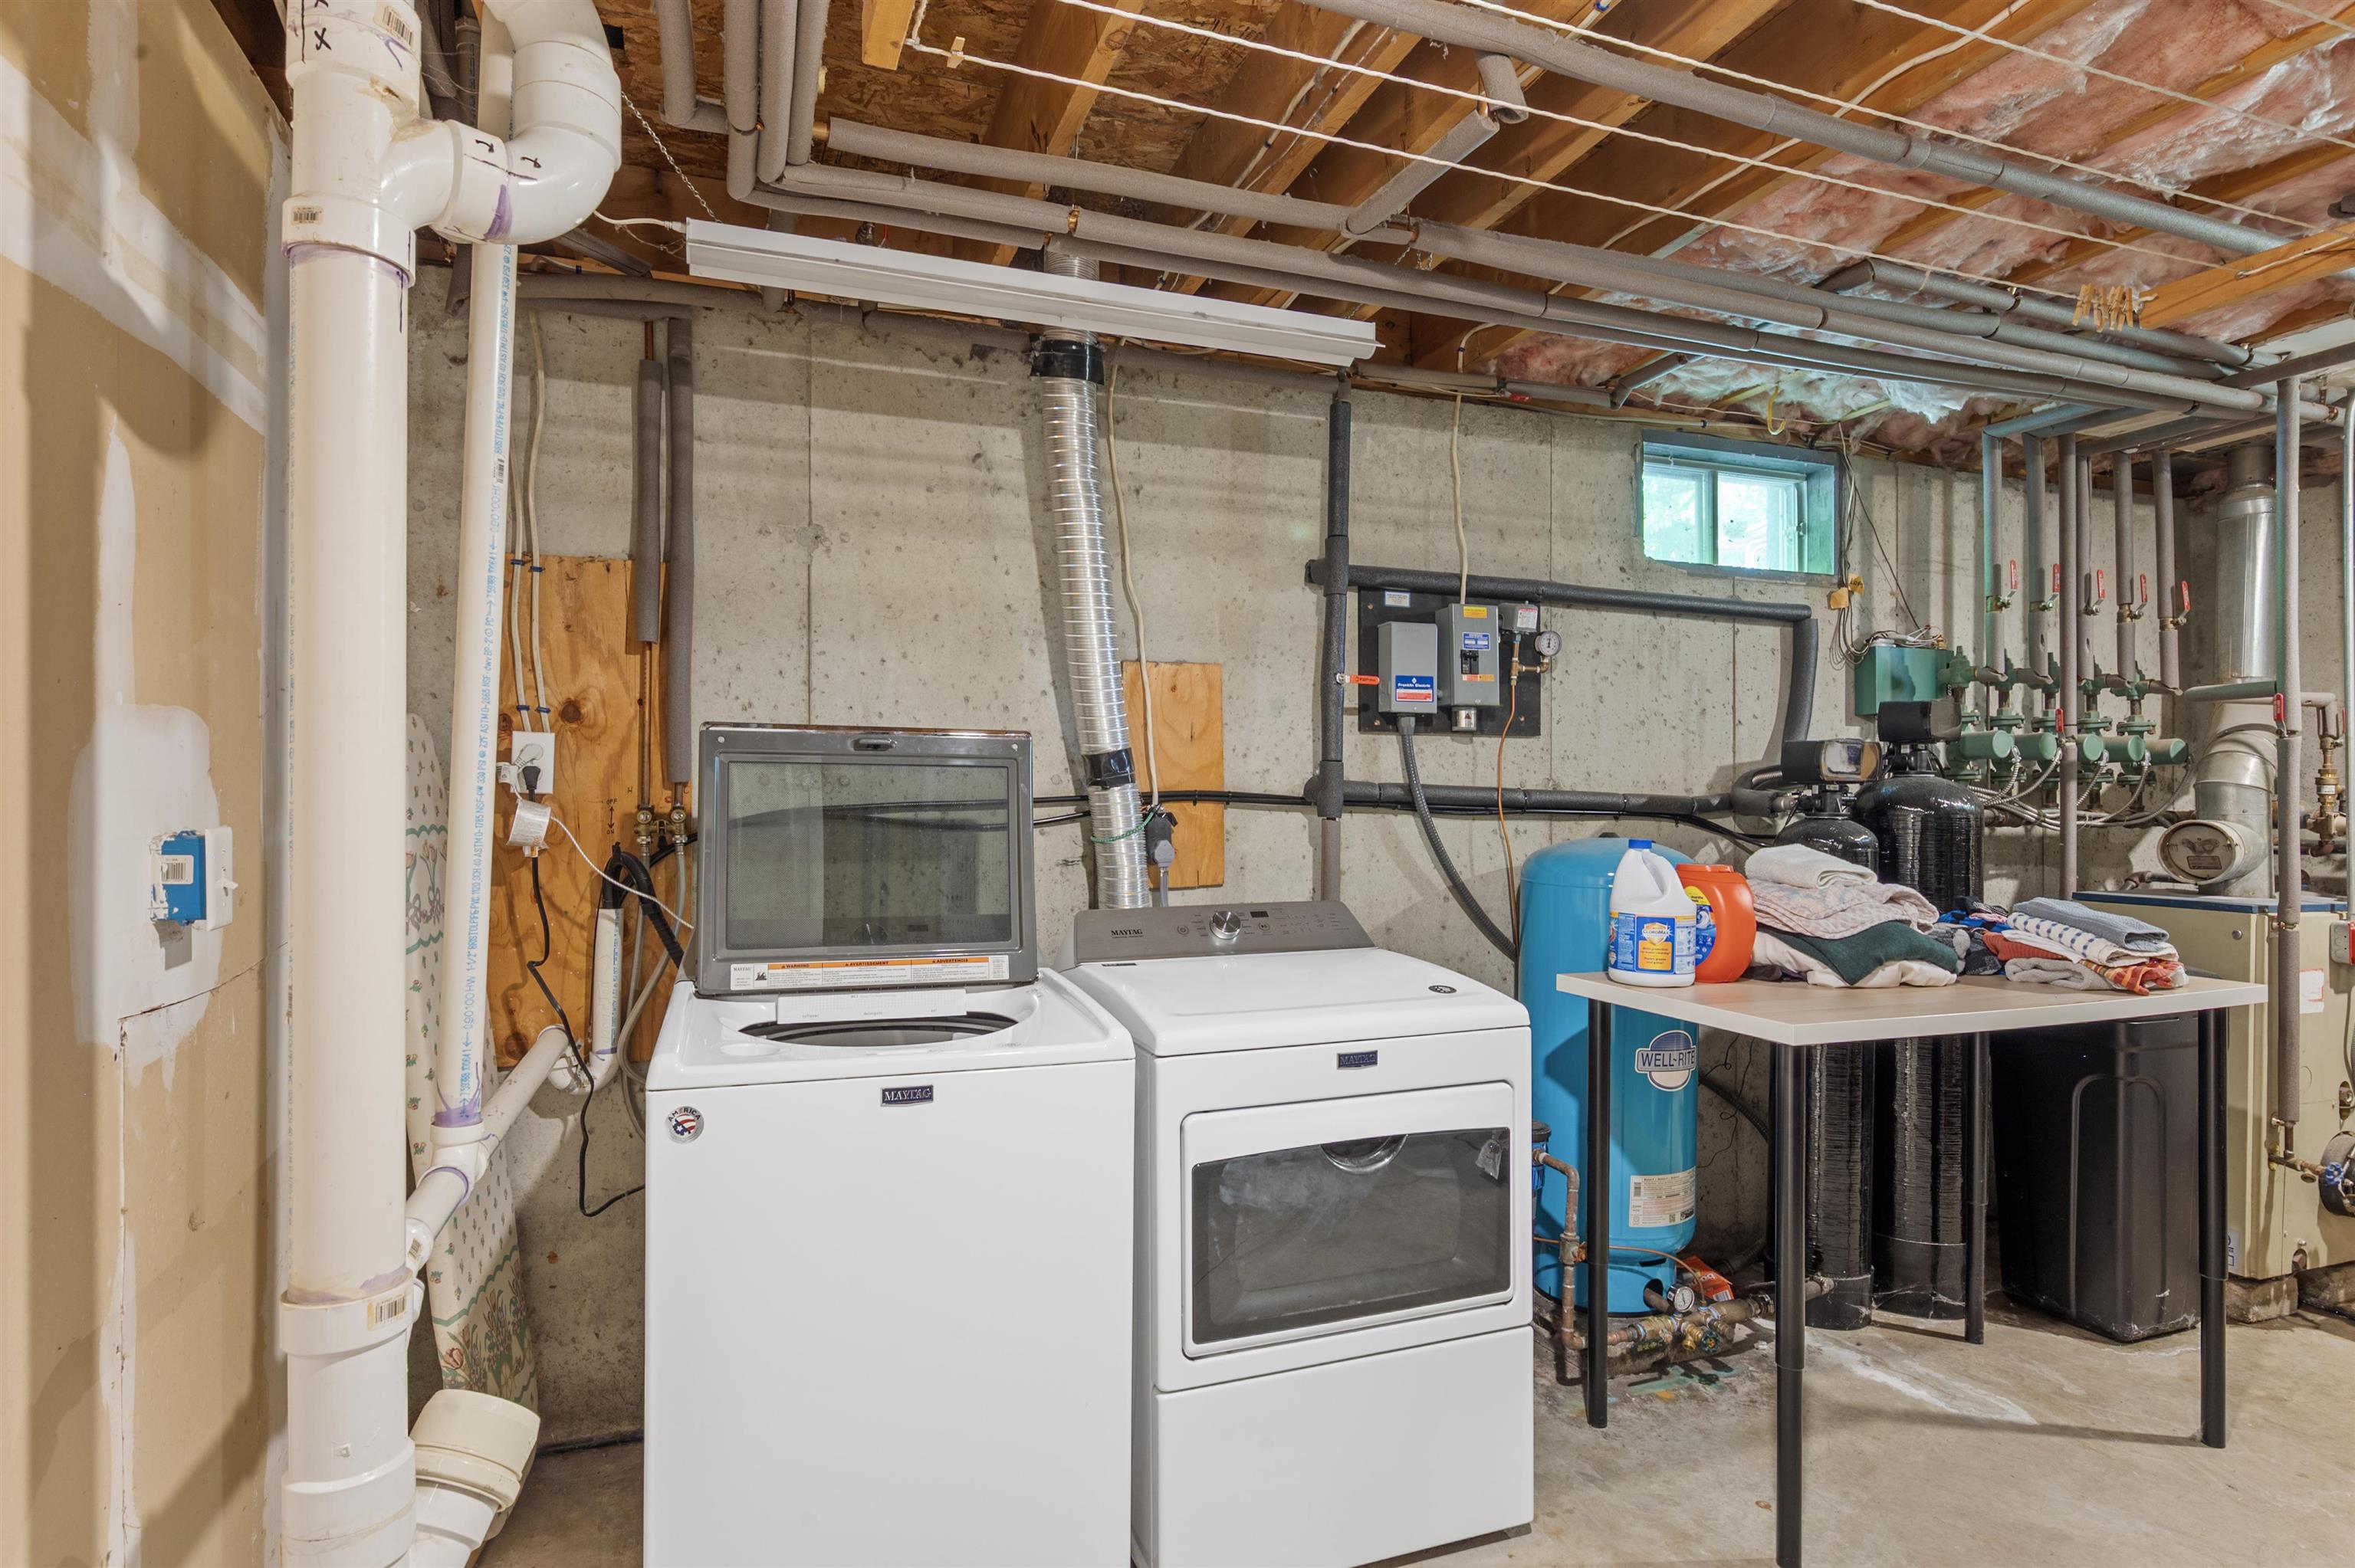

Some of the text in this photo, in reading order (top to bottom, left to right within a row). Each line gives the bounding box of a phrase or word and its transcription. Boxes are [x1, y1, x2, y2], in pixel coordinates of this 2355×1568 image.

[473, 837, 484, 858] ASTM
[479, 713, 490, 733] ASTM
[1340, 1054, 1376, 1065] MAYTAG
[884, 1087, 931, 1102] MAYTAG
